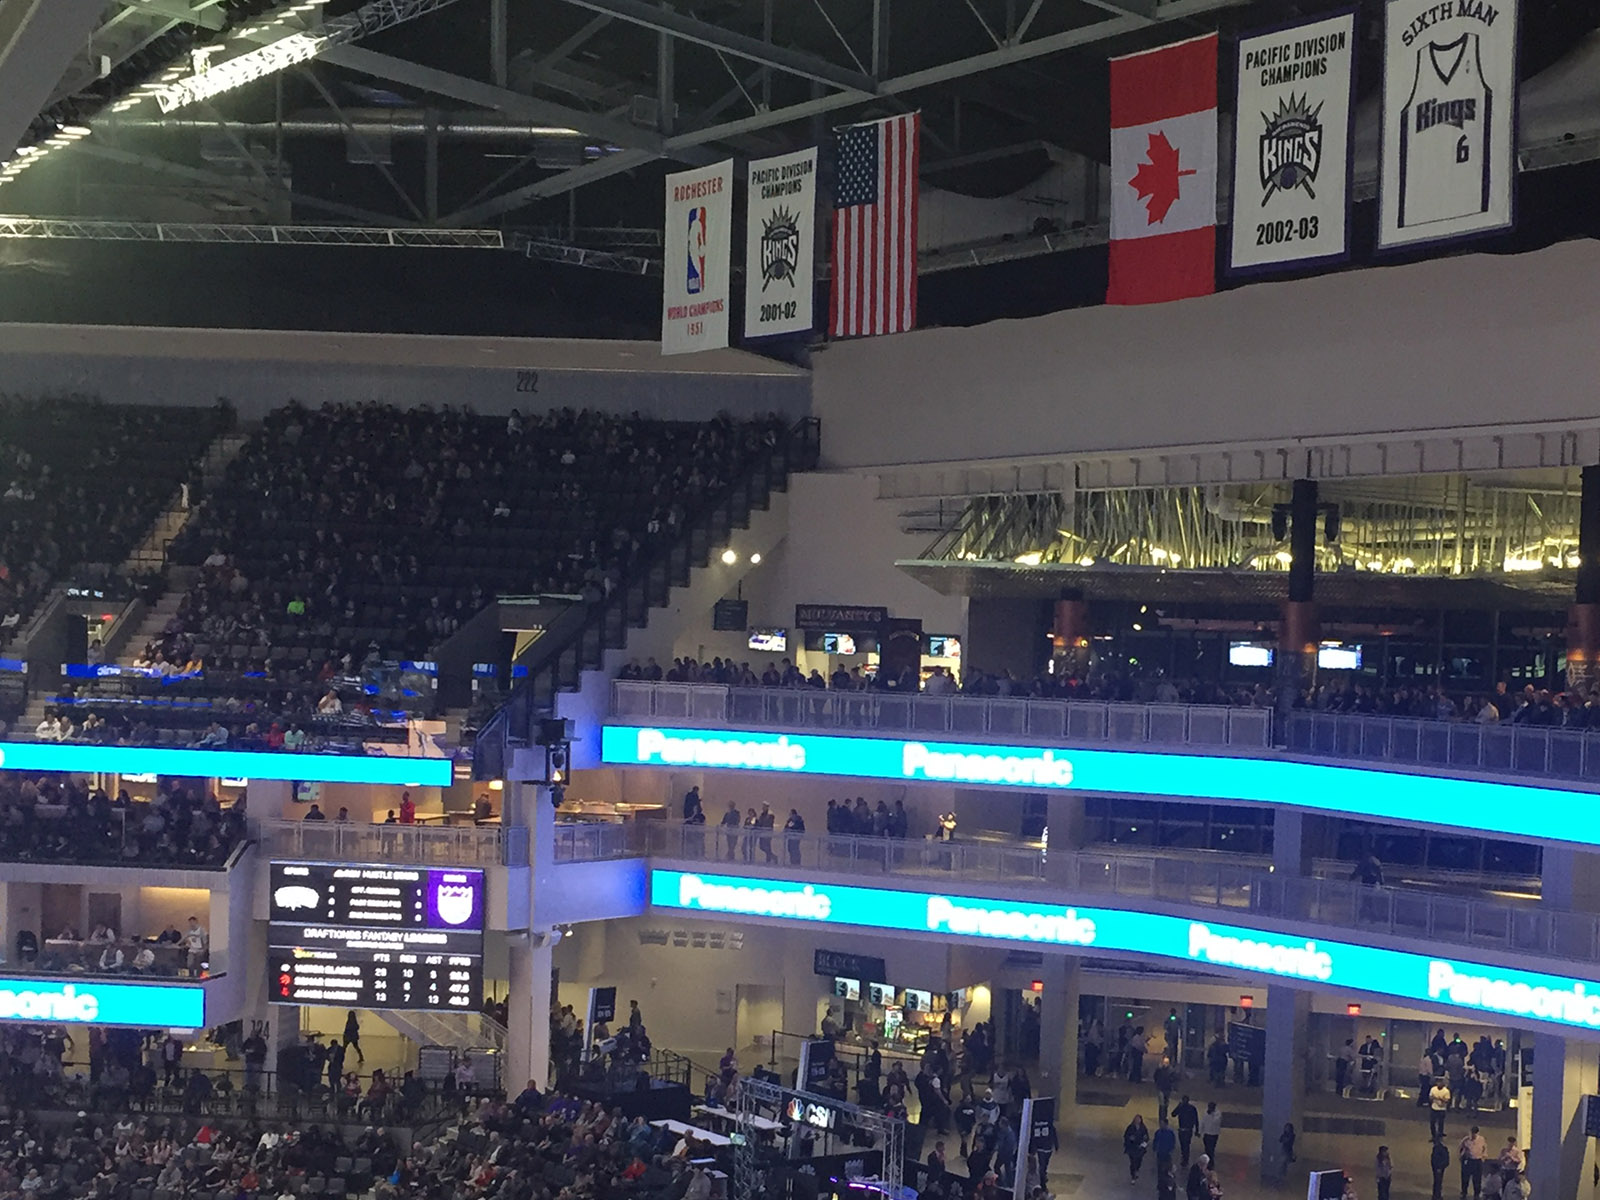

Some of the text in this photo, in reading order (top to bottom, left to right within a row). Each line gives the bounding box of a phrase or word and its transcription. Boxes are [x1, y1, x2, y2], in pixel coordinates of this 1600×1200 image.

[1402, 0, 1499, 47] SIXTH MAN
[1246, 31, 1345, 70] PACIFIC DIVISION
[1261, 57, 1327, 87] CHAMPIONS
[1416, 98, 1476, 134] Kings
[1263, 130, 1319, 180] KINGS
[1456, 134, 1469, 163] 6
[752, 159, 813, 185] PACIFIC DIVISION
[674, 176, 723, 202] ROCHESTER
[761, 179, 802, 199] CHAMPIONS
[1256, 216, 1319, 245] 2002-03
[763, 235, 797, 269] KINGS
[667, 299, 724, 320] WORLD CHAMPIONS
[760, 301, 797, 322] 2001-02
[517, 371, 539, 392] 222
[638, 729, 806, 770] Panasonic
[904, 742, 1074, 786] Panasonic
[679, 873, 832, 920] Panasonic
[927, 895, 1096, 945] Panasonic
[1188, 922, 1332, 980] Panasonic
[404, 994, 411, 1003] 7
[1428, 960, 1600, 1025] Panasonic
[806, 1103, 836, 1129] CSN
